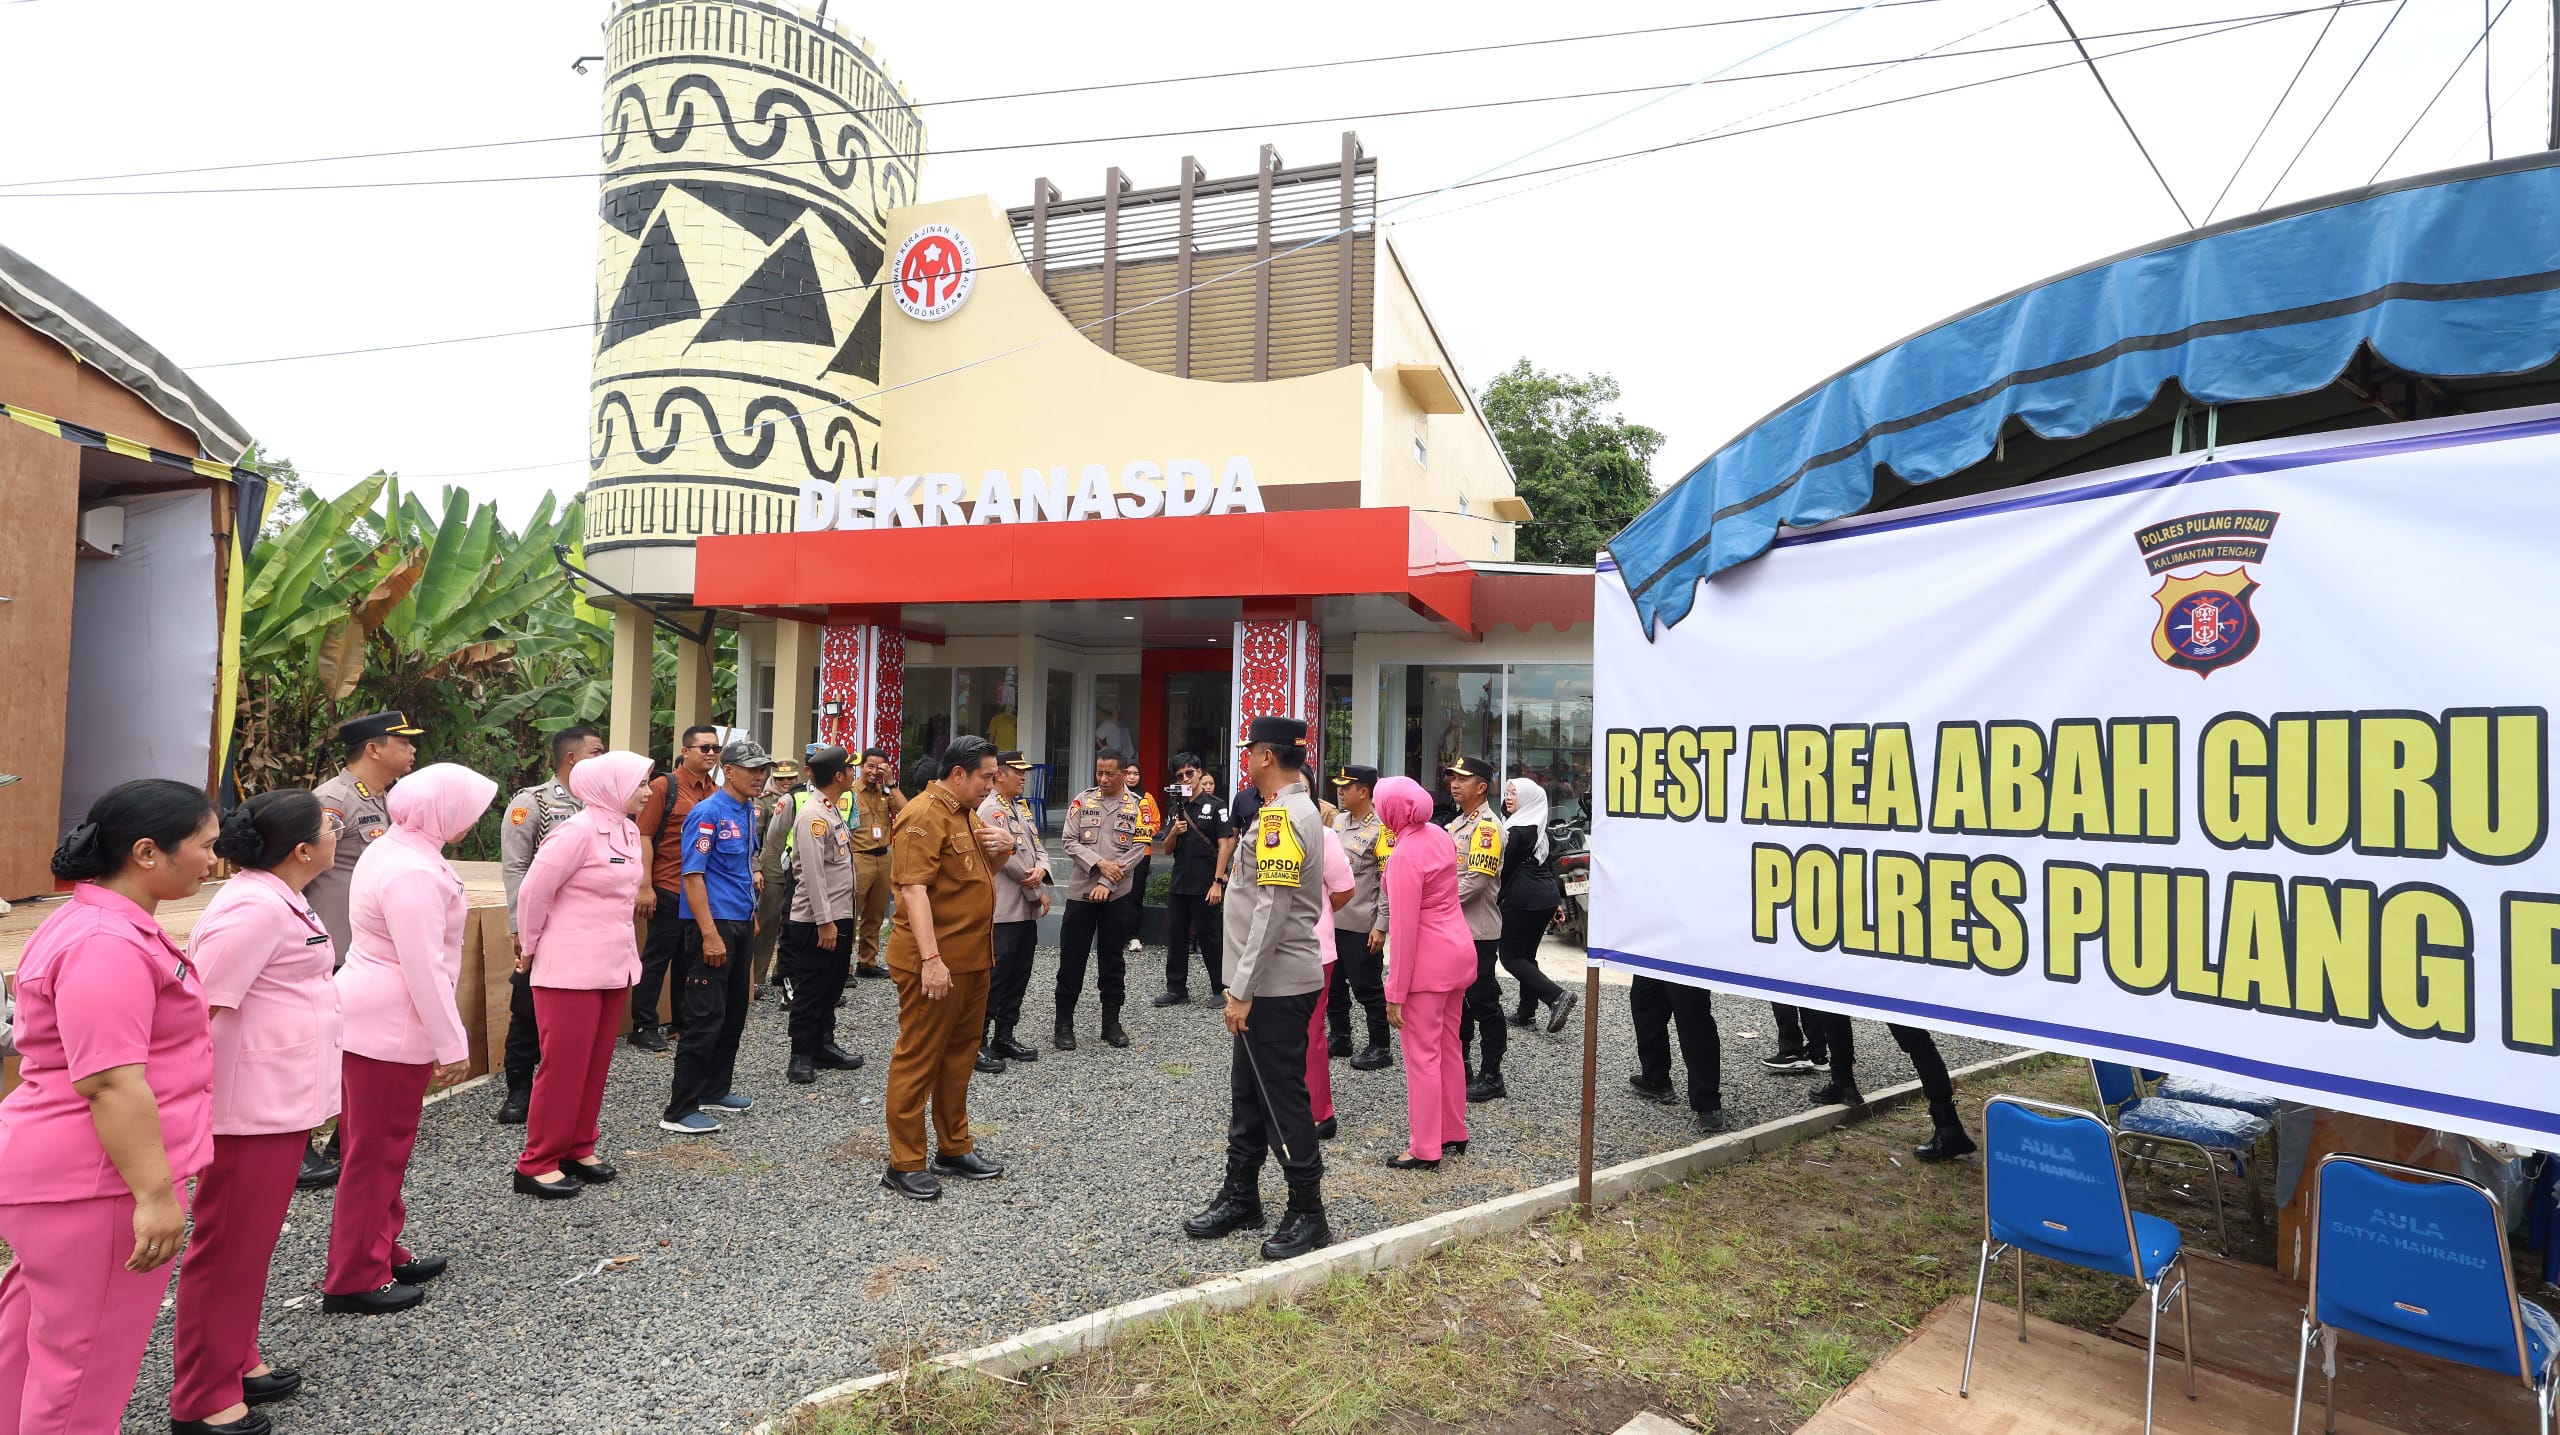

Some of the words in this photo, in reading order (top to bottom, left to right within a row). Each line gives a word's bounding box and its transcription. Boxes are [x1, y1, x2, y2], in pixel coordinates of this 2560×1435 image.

[900, 226, 950, 254] KERAJINAN
[905, 299, 956, 316] INDONESIA
[799, 455, 1266, 532] DEKRANASDA
[2142, 523, 2184, 547] POLRES
[2187, 516, 2231, 534] PULANG
[2234, 516, 2270, 532] PISAU
[2153, 548, 2214, 569] KALIMANTAN
[2217, 546, 2258, 558] TENGAH
[1605, 725, 1736, 823] REST
[1741, 722, 1922, 832] AREA
[1929, 716, 2180, 844] ABAH
[2197, 706, 2549, 865] GURU
[1751, 842, 2029, 977] POLRES
[2043, 860, 2475, 1043] PULANG
[1995, 1151, 2037, 1170] SATYA
[2021, 1138, 2075, 1162] AULA
[2331, 1220, 2389, 1246] SATYA
[2370, 1208, 2444, 1240] AULA
